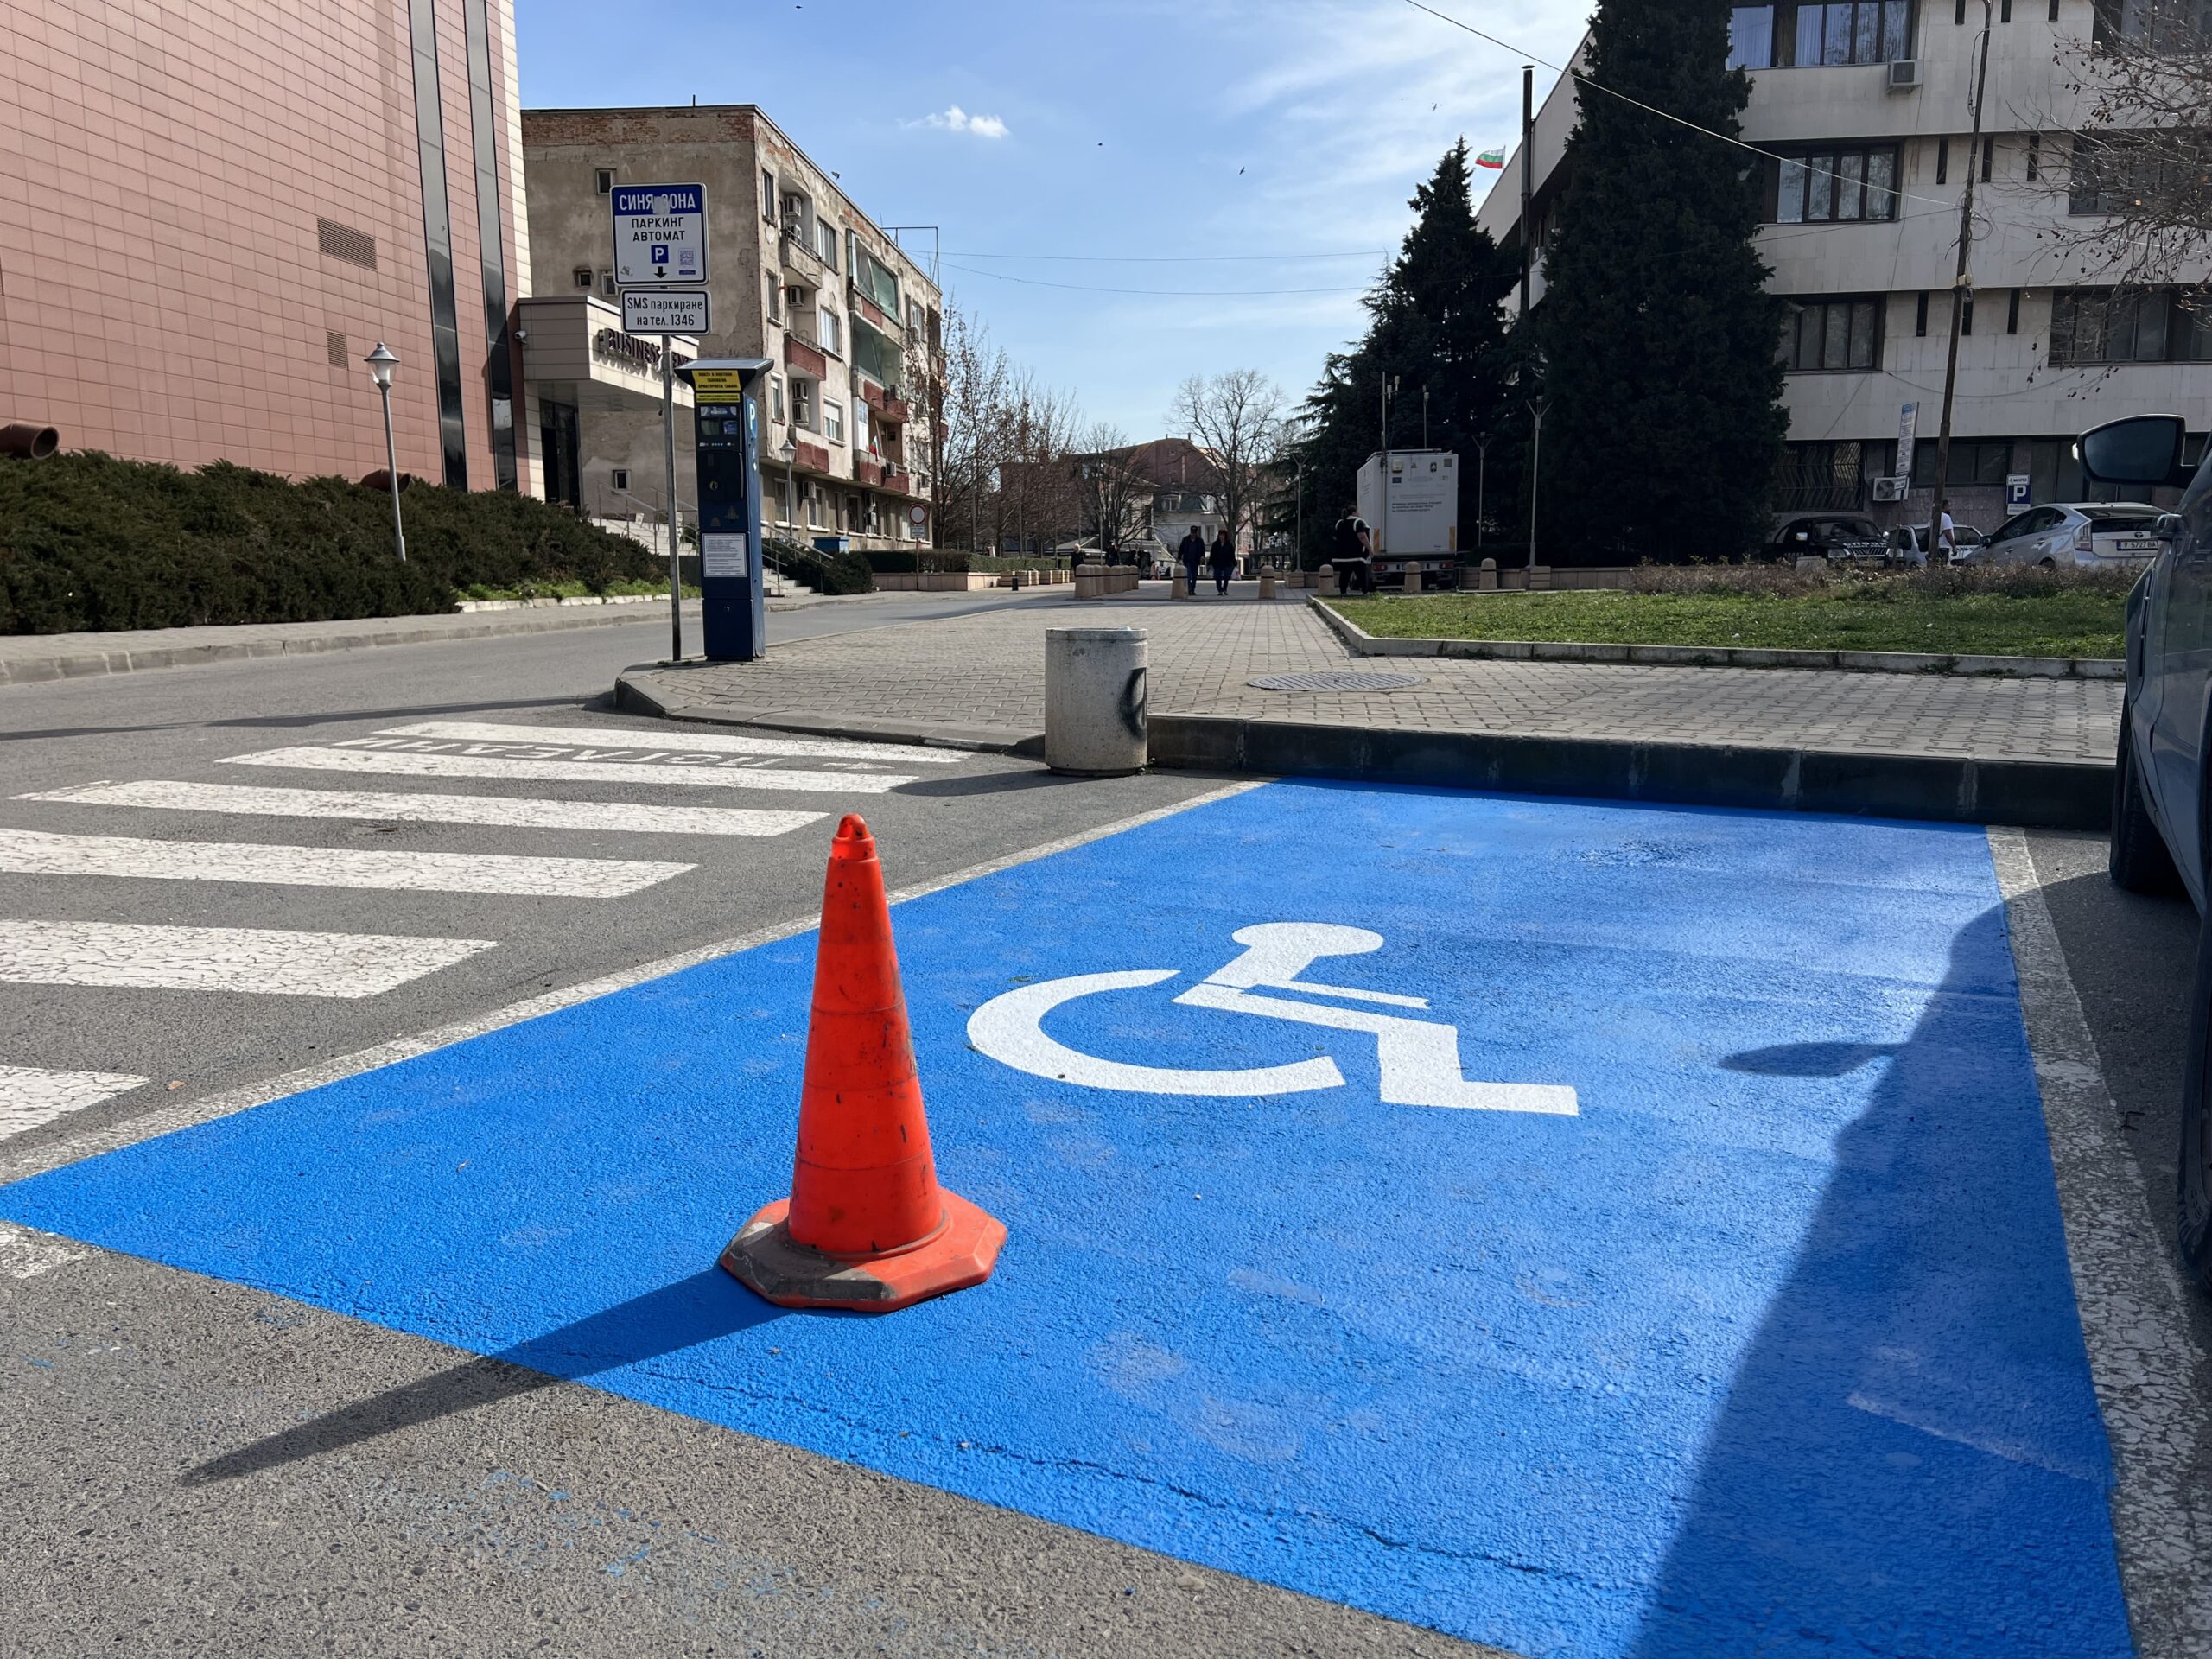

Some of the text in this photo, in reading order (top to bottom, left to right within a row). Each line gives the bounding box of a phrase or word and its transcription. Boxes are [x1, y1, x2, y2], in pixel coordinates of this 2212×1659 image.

[619, 194, 653, 210] СИНЯ
[632, 216, 684, 228] ПАРКИНГ
[632, 230, 685, 242] АВТОМАТ
[655, 247, 664, 261] P
[627, 297, 702, 312] SMS паркиране
[637, 314, 694, 326] на тел. 1346
[604, 327, 661, 364] BUSINESS
[749, 403, 756, 430] P
[2013, 485, 2027, 502] P
